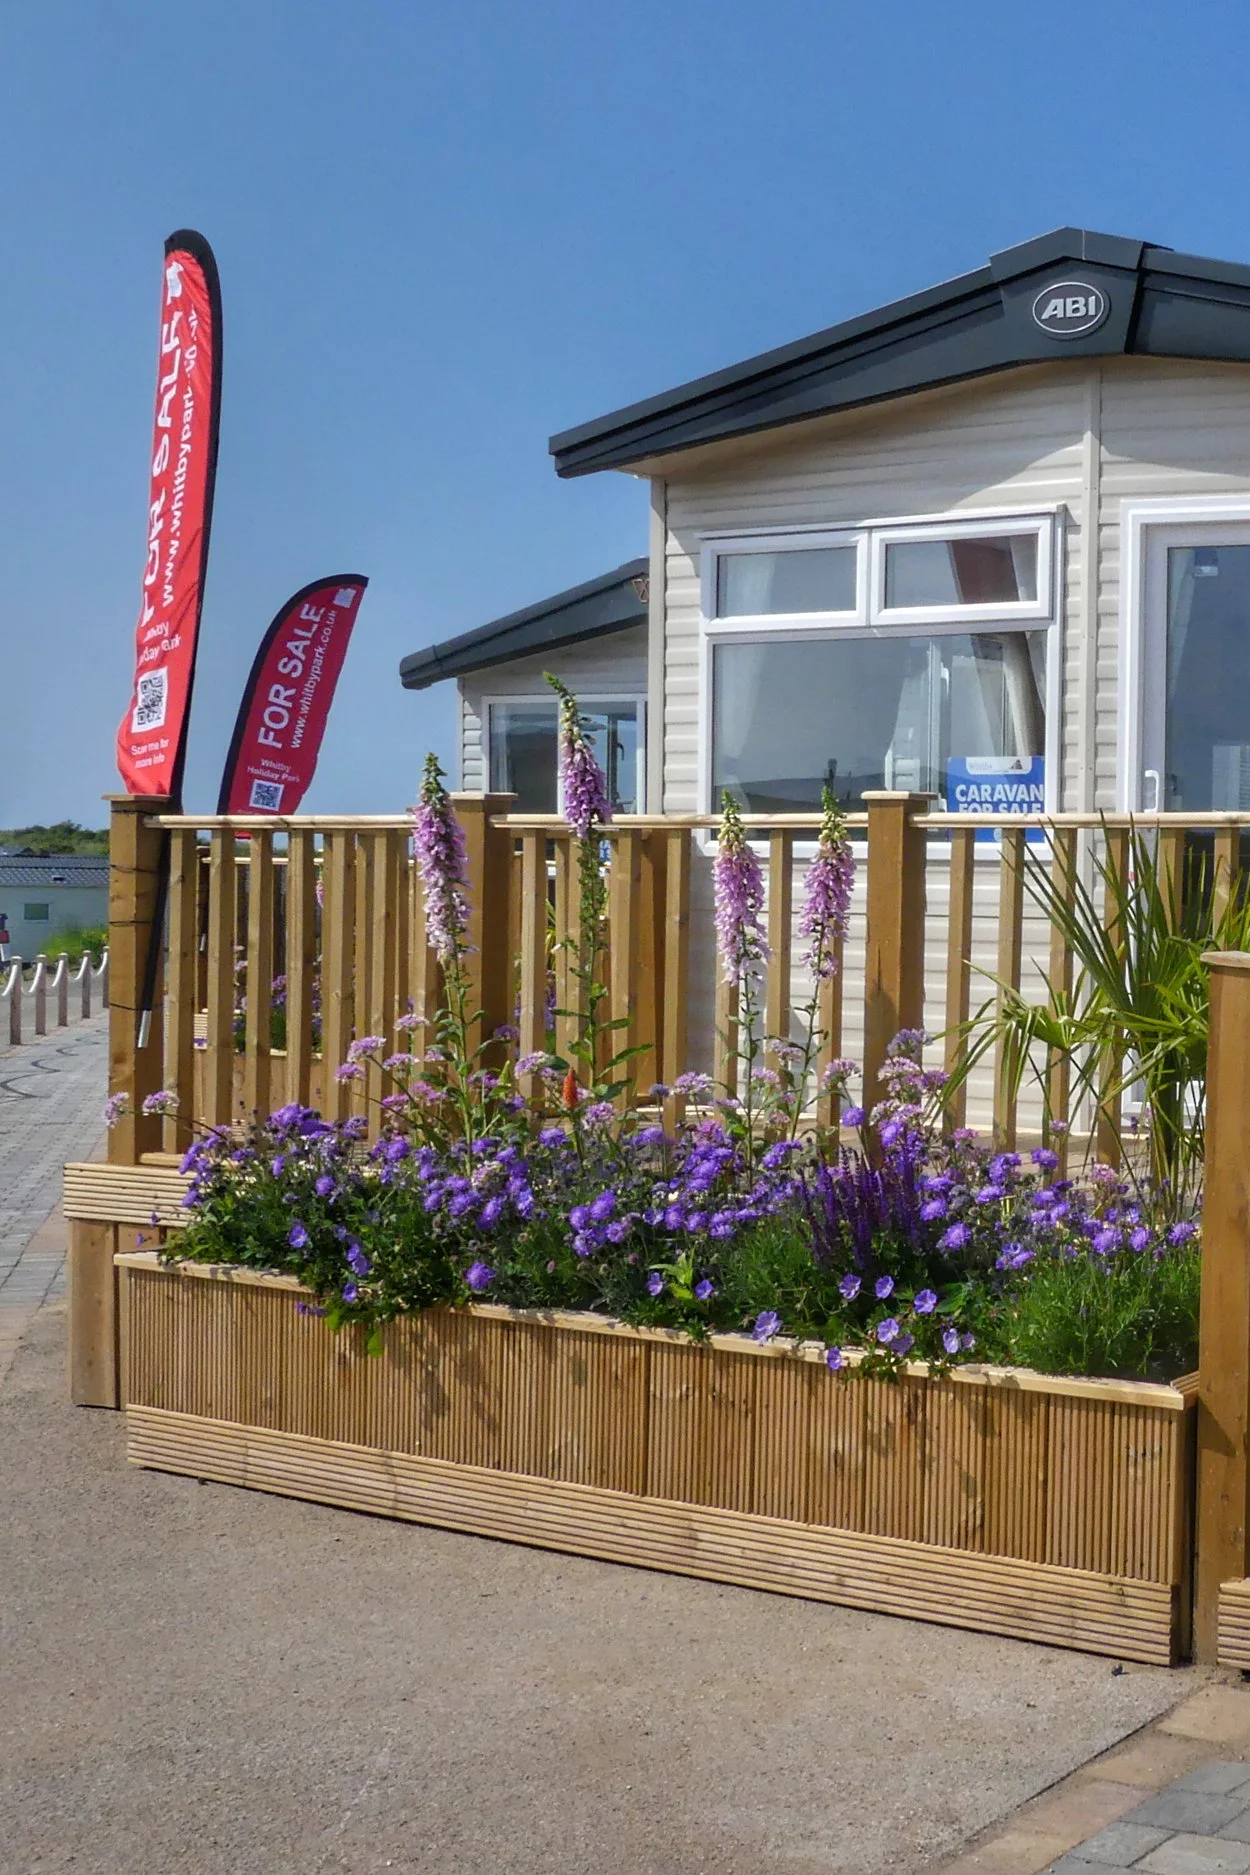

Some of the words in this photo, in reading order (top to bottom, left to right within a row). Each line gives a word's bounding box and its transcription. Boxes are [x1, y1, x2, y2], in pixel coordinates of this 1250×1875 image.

[1041, 296, 1096, 320] ABI
[257, 684, 297, 749] FOR
[277, 603, 326, 678] SALE
[955, 784, 1044, 802] CARAVAN
[959, 802, 993, 813] FOR
[998, 802, 1042, 813] SALE
